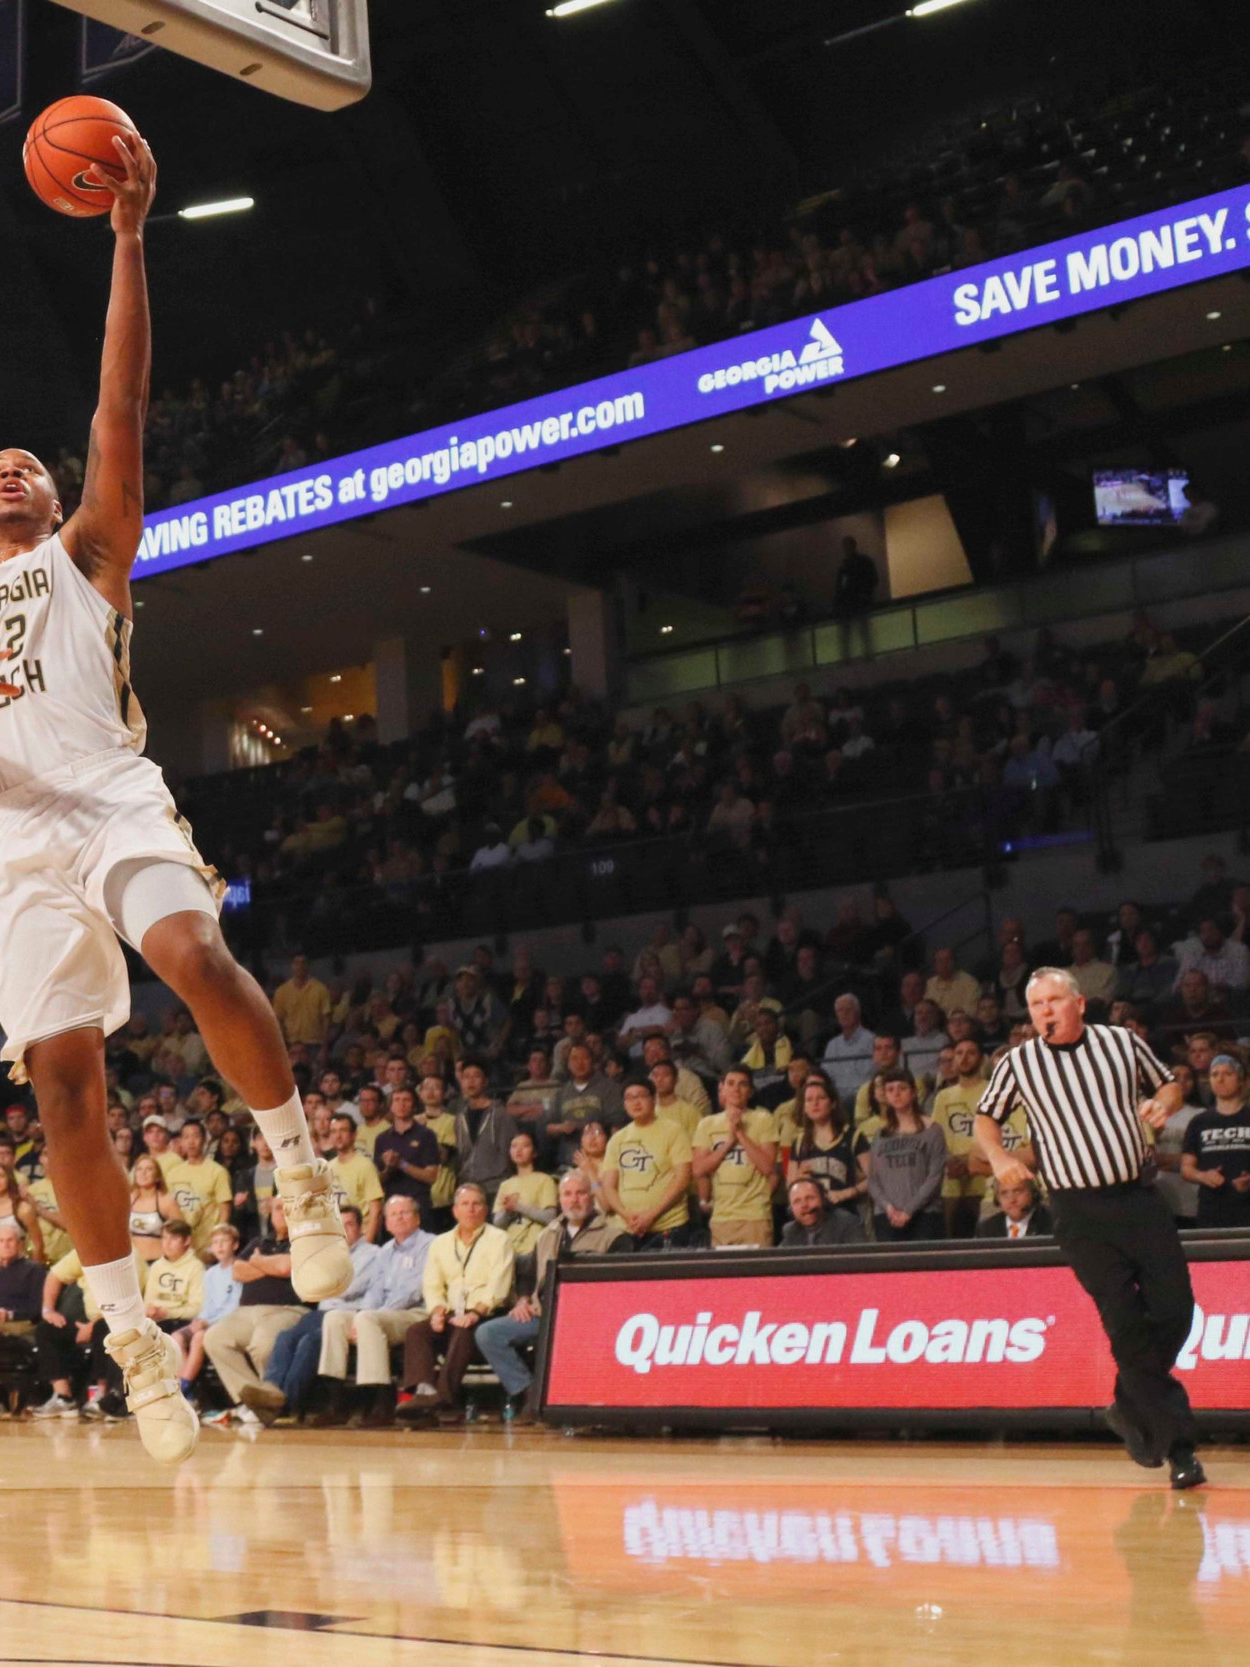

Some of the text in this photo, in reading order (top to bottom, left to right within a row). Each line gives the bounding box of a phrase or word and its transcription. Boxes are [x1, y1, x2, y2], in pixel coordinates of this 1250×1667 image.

[953, 259, 1060, 326] SAVE
[1066, 207, 1237, 294] MONEY.
[697, 349, 797, 393] GEORGIA
[764, 356, 845, 394] POWER
[134, 391, 645, 563] AVING REBATES at georgiapower.com
[1201, 1127, 1250, 1142] TECH
[619, 1149, 654, 1172] GT
[159, 1272, 183, 1292] GT
[615, 1310, 848, 1373] Quicken
